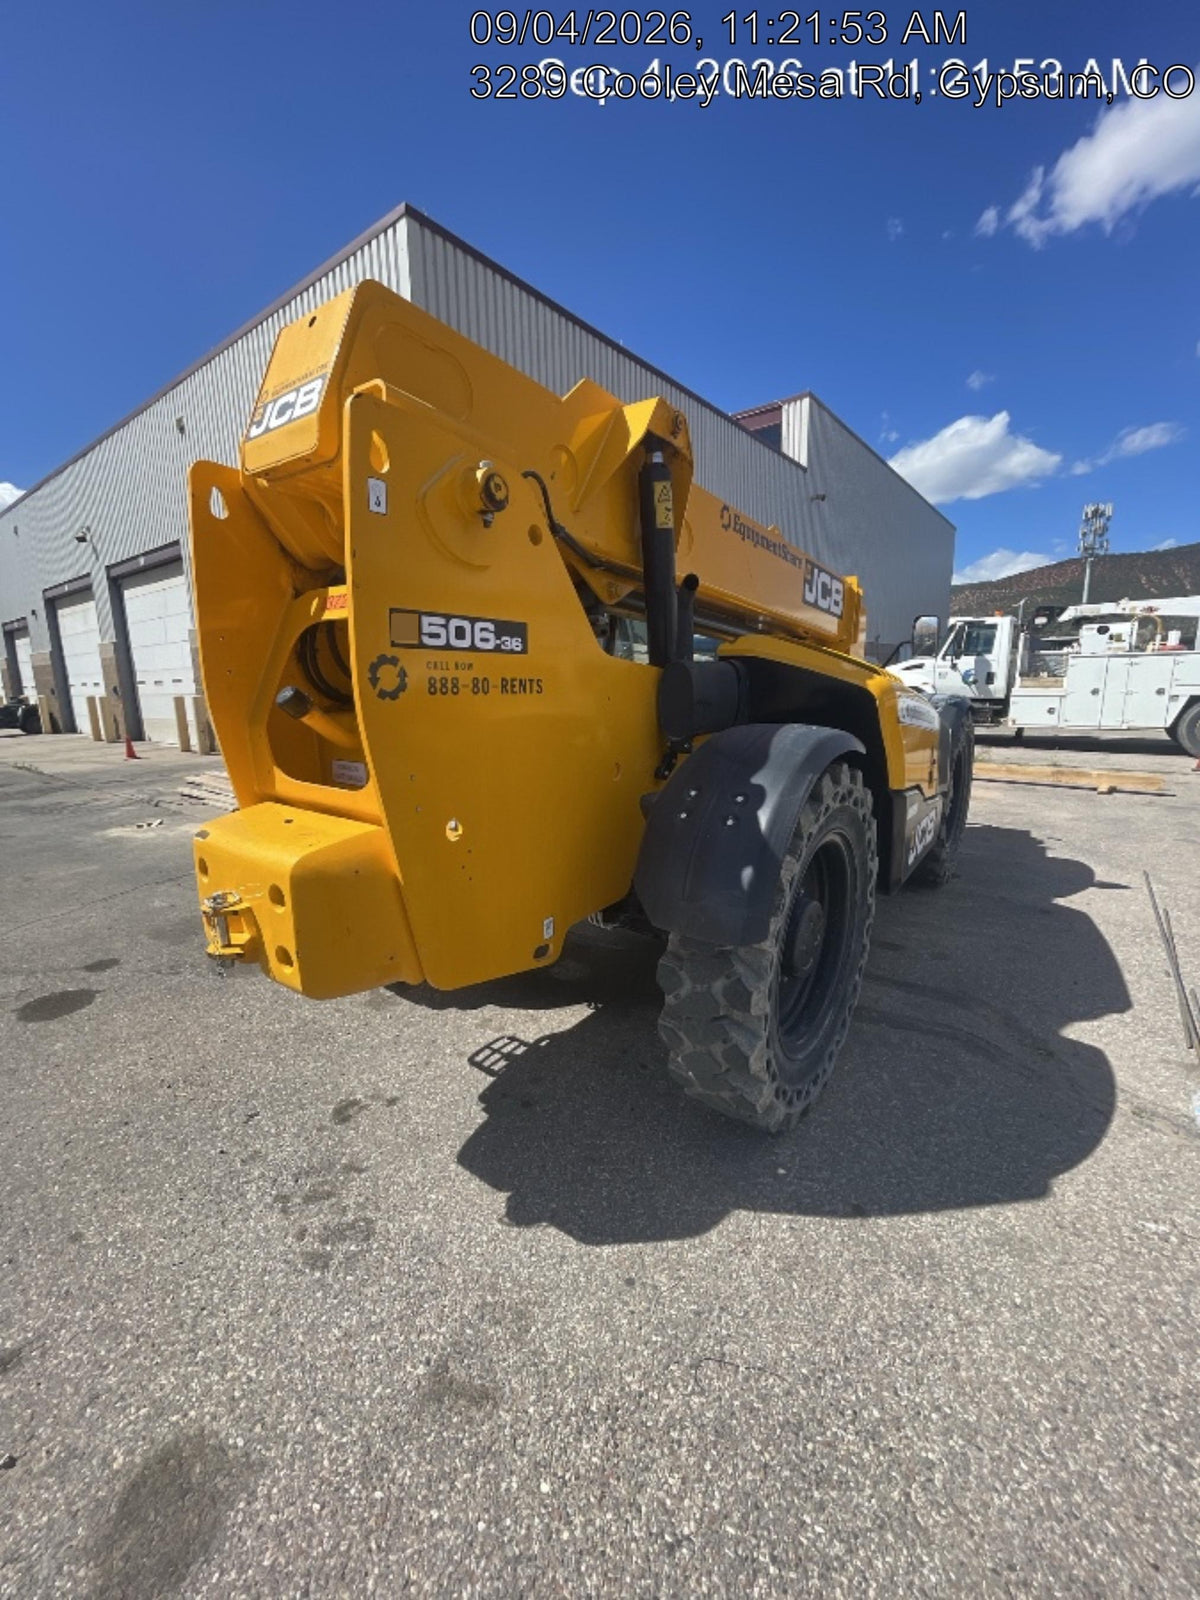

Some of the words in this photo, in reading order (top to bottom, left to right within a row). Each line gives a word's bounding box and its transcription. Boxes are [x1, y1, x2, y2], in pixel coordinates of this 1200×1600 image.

[248, 377, 324, 439] JCB
[803, 567, 844, 617] JCB
[426, 661, 450, 671] CALL
[454, 662, 474, 671] NOW
[427, 676, 544, 696] 888-80-RENTS
